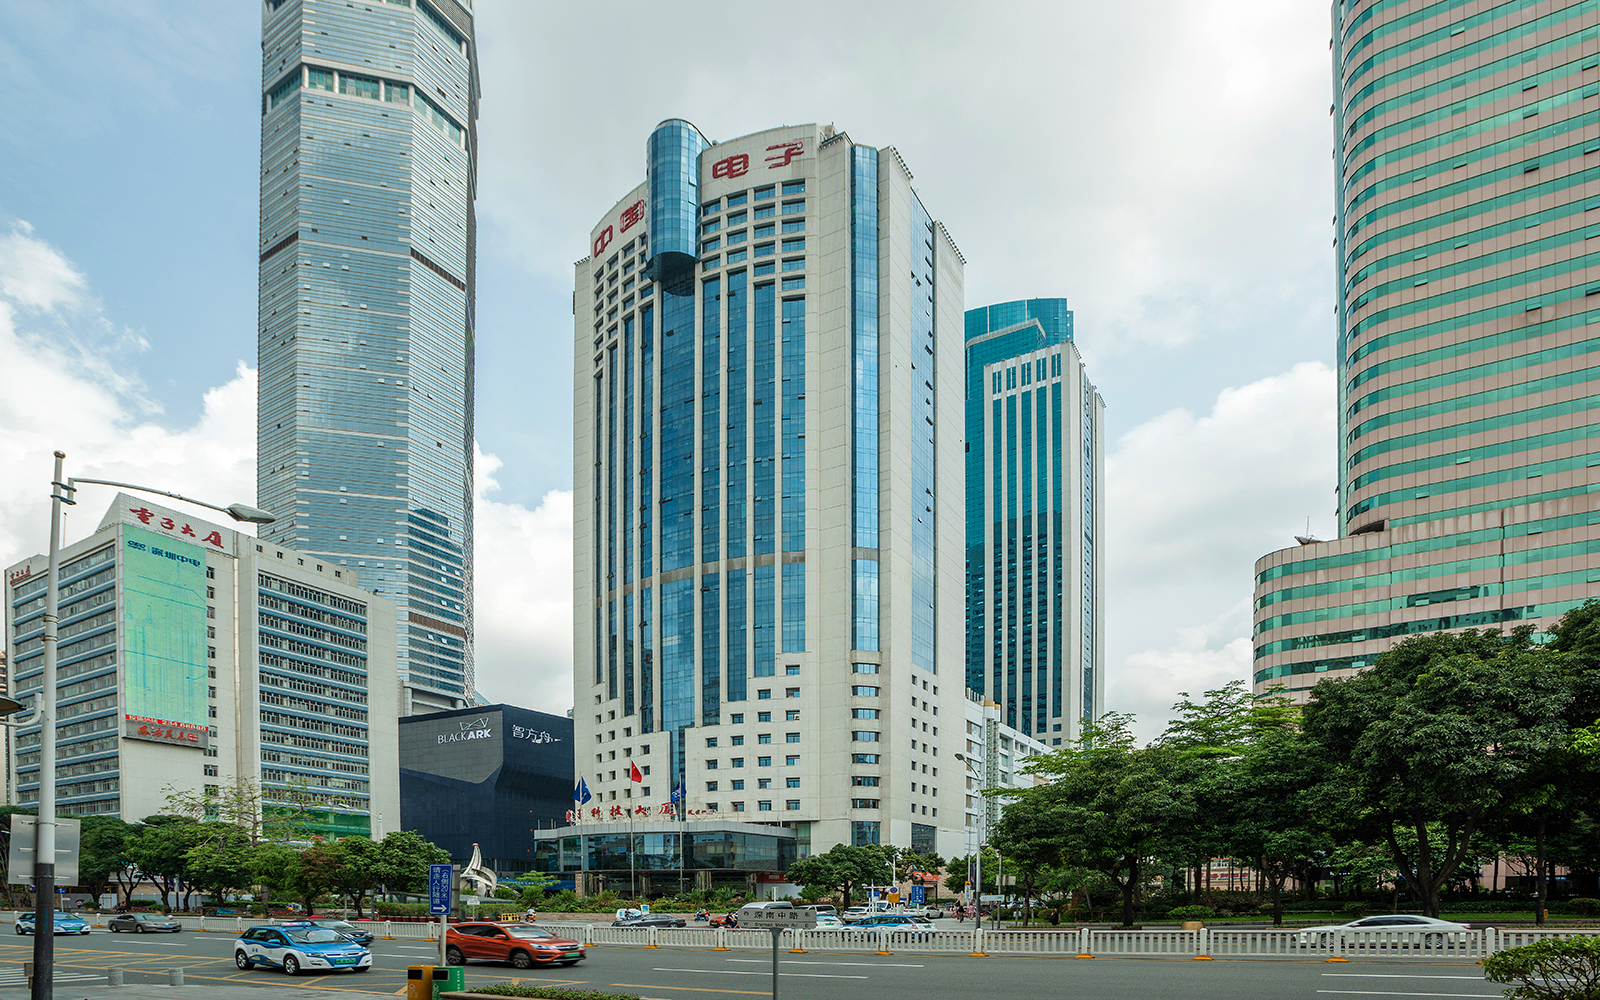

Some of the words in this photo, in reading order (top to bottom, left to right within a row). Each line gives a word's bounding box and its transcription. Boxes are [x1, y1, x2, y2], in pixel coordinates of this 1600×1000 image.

[512, 724, 551, 743] 智方舟
[754, 911, 798, 919] 深南中路
